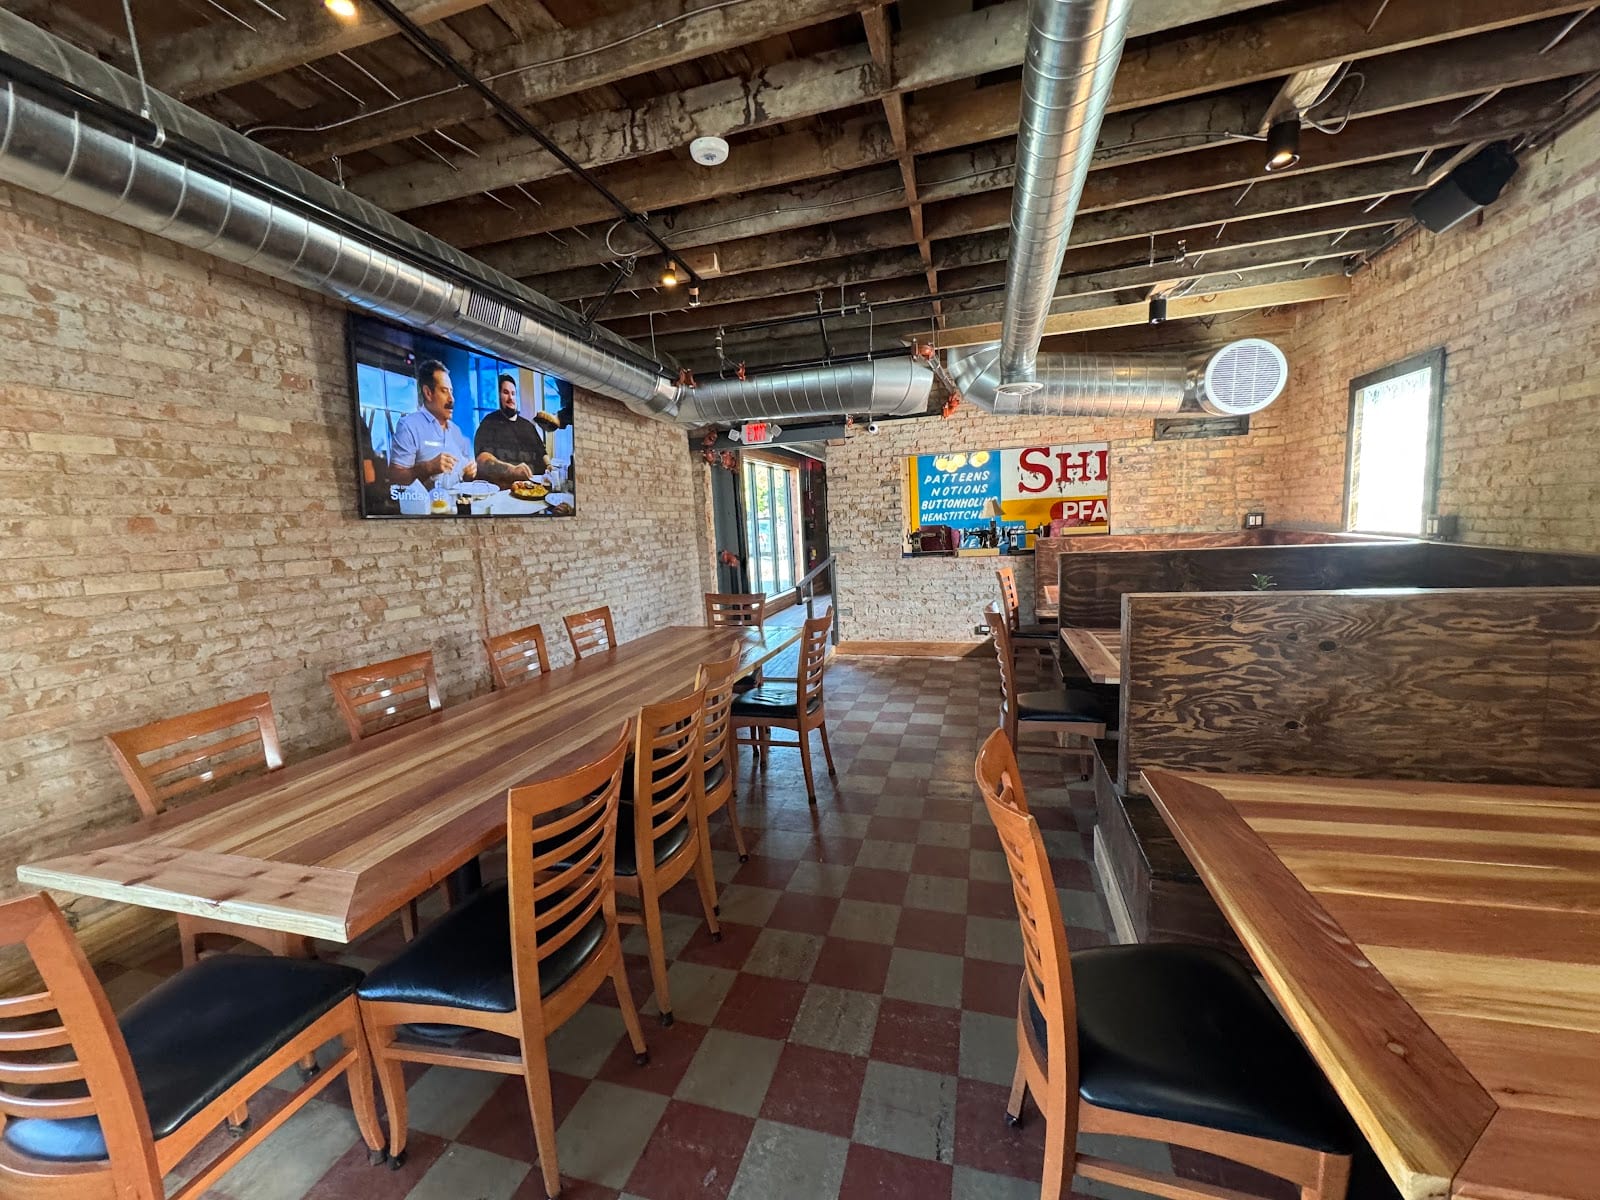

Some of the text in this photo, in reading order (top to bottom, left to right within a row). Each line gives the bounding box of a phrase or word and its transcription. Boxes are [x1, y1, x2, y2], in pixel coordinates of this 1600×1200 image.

[746, 423, 767, 442] EXIT
[924, 471, 990, 484] PATTERNS
[931, 484, 988, 497] NOTIONS
[922, 496, 998, 510] BUTTONHOLI
[1062, 500, 1108, 522] PFA
